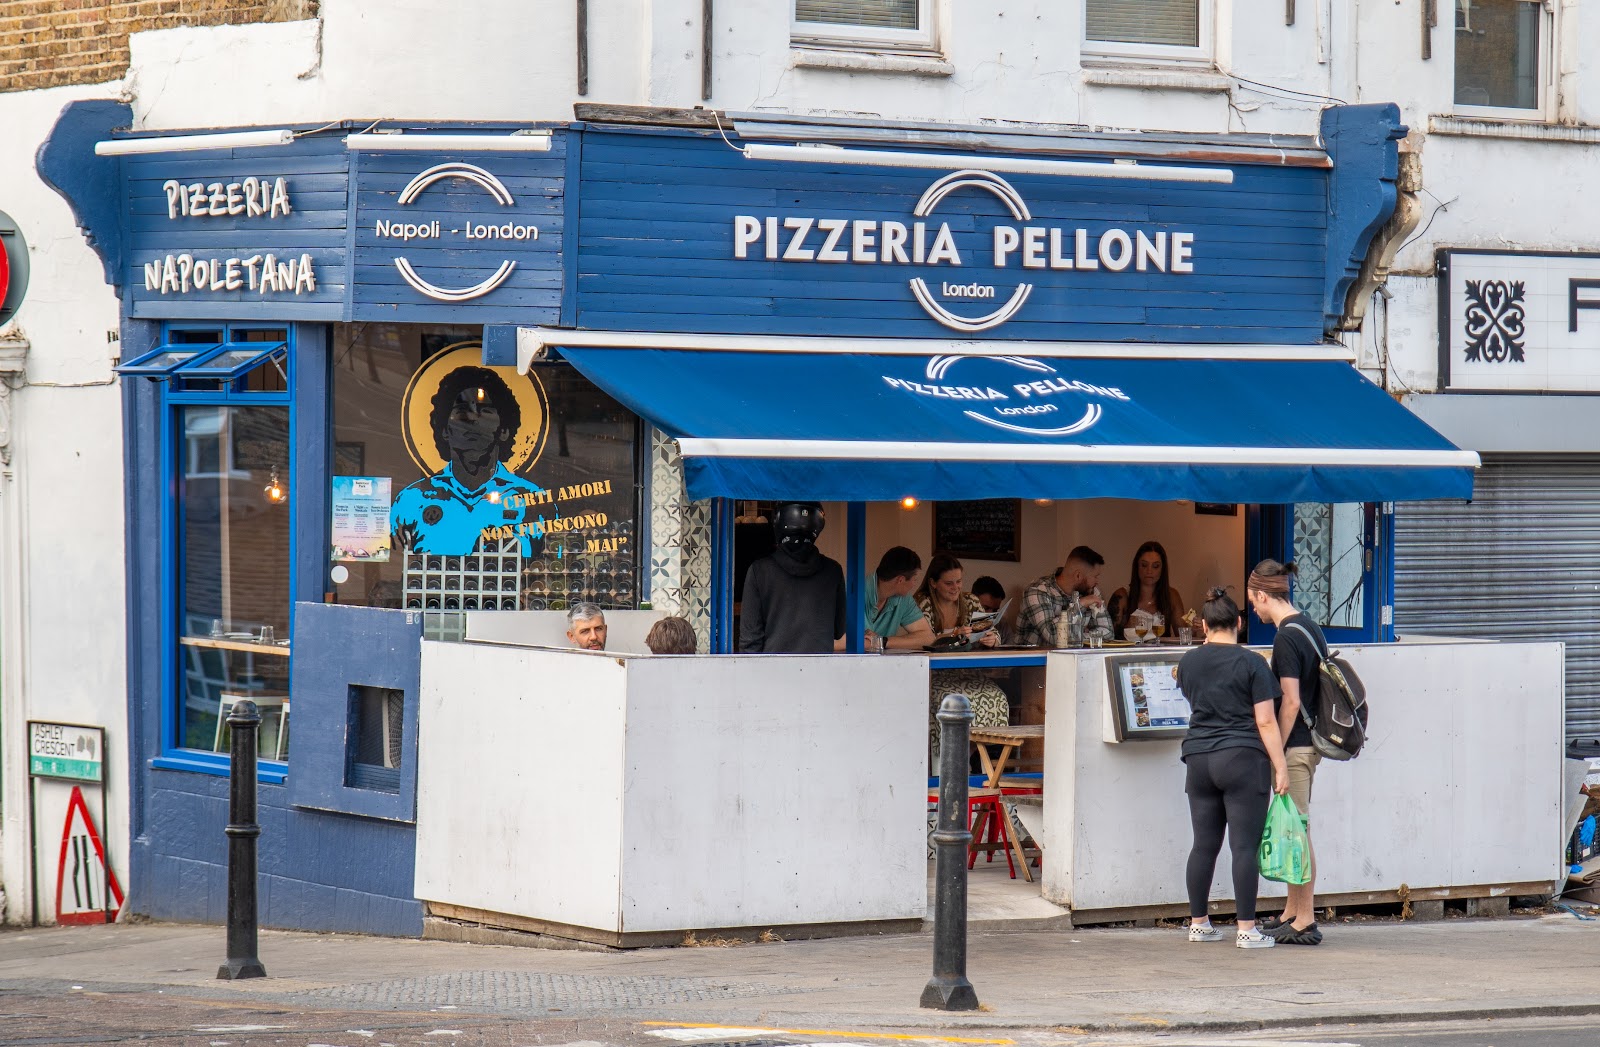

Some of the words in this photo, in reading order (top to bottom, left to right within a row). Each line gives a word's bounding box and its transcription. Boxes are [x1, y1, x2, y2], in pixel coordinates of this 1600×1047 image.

[163, 176, 292, 219] PIZZERIA
[375, 219, 440, 241] Napoli
[465, 221, 539, 241] London
[733, 214, 961, 266] PIZZERIA
[993, 225, 1195, 274] PELLONE
[144, 253, 317, 296] NAPOLETANA
[942, 281, 995, 298] London
[881, 375, 1010, 401] PIZZERIA
[1013, 377, 1132, 401] PELLONE
[994, 402, 1059, 417] London
[557, 479, 613, 502] AMORI
[480, 524, 515, 543] NON
[518, 512, 609, 538] FINISCONO
[35, 723, 64, 741] ASHLEY
[34, 738, 76, 757] CRESCENT
